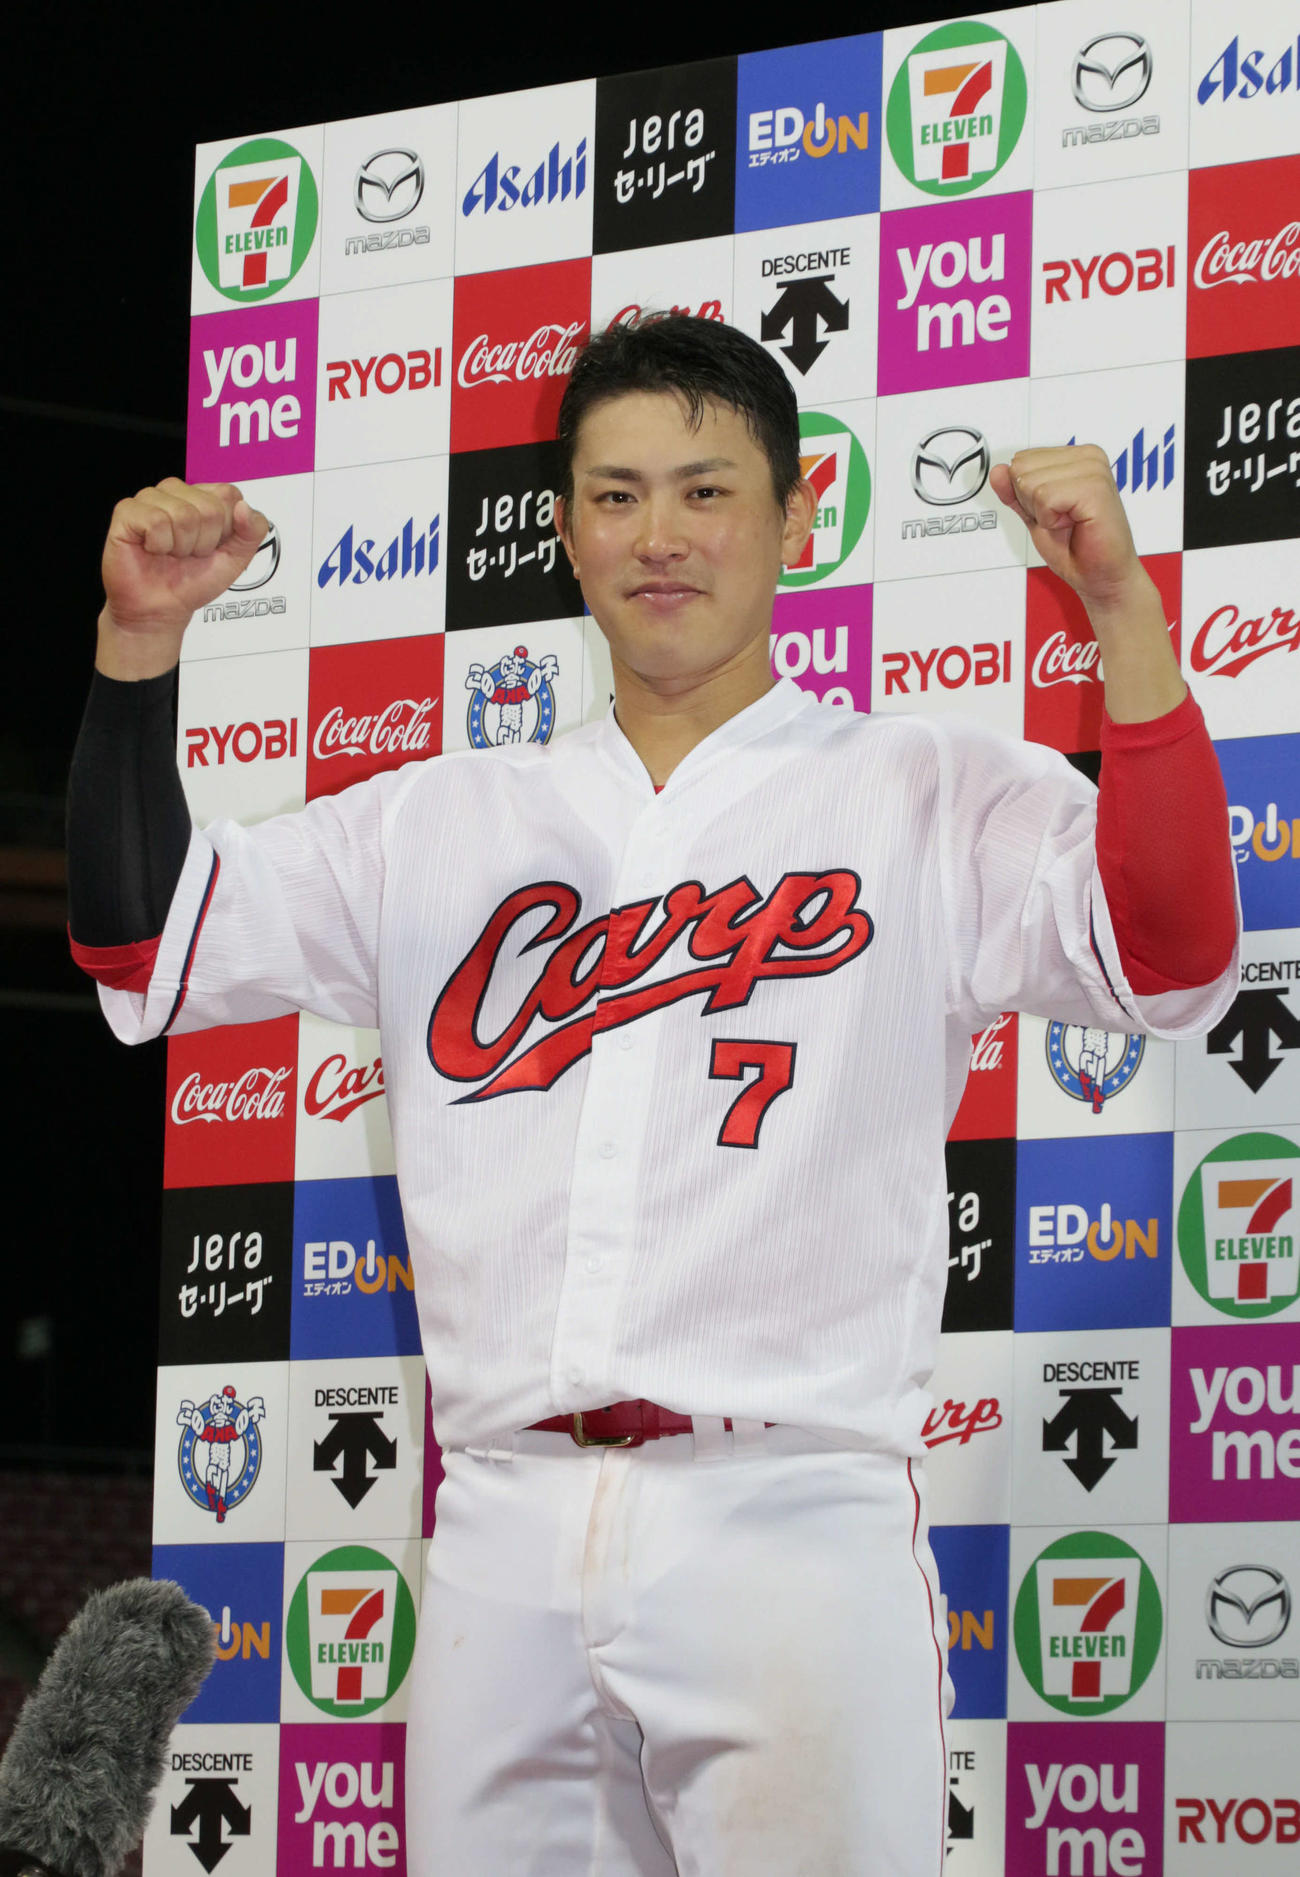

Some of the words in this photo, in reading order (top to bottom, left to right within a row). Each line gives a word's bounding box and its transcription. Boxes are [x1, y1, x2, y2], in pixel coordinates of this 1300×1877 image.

[1197, 35, 1300, 105] Asa
[749, 103, 869, 158] EDION
[924, 61, 992, 179] 7
[462, 138, 586, 216] Asahi
[229, 175, 288, 286] 7
[1194, 222, 1300, 289] Coca-Co
[762, 248, 850, 277] DESCENTE
[896, 234, 1005, 310] you
[1043, 246, 1175, 304] RYOBI
[458, 320, 586, 388] Coca-Cola
[917, 295, 1011, 352] me
[203, 338, 297, 408] you
[327, 347, 442, 401] RYOBI
[219, 395, 301, 447] me
[318, 514, 440, 589] Asahi
[882, 641, 1011, 695] RYOBI
[1190, 605, 1300, 678] Car
[186, 718, 298, 768] RYOBI
[313, 697, 439, 760] Coca-Cola
[426, 868, 875, 1106] Carp
[171, 1066, 293, 1125] Coca-Cola
[708, 1038, 798, 1149] 7
[1029, 1203, 1158, 1262] EDION
[1218, 1178, 1292, 1299] 7
[315, 1387, 398, 1407] DESCENTE
[1043, 1361, 1139, 1383] DESCENTE
[1189, 1364, 1300, 1434] you
[1212, 1429, 1300, 1480] me
[321, 1589, 384, 1700] 7
[1053, 1578, 1125, 1697] 7
[172, 1753, 252, 1772] DESCENTE
[295, 1762, 394, 1824] you
[1025, 1763, 1139, 1829] you
[313, 1821, 399, 1868] me
[1046, 1828, 1145, 1877] me
